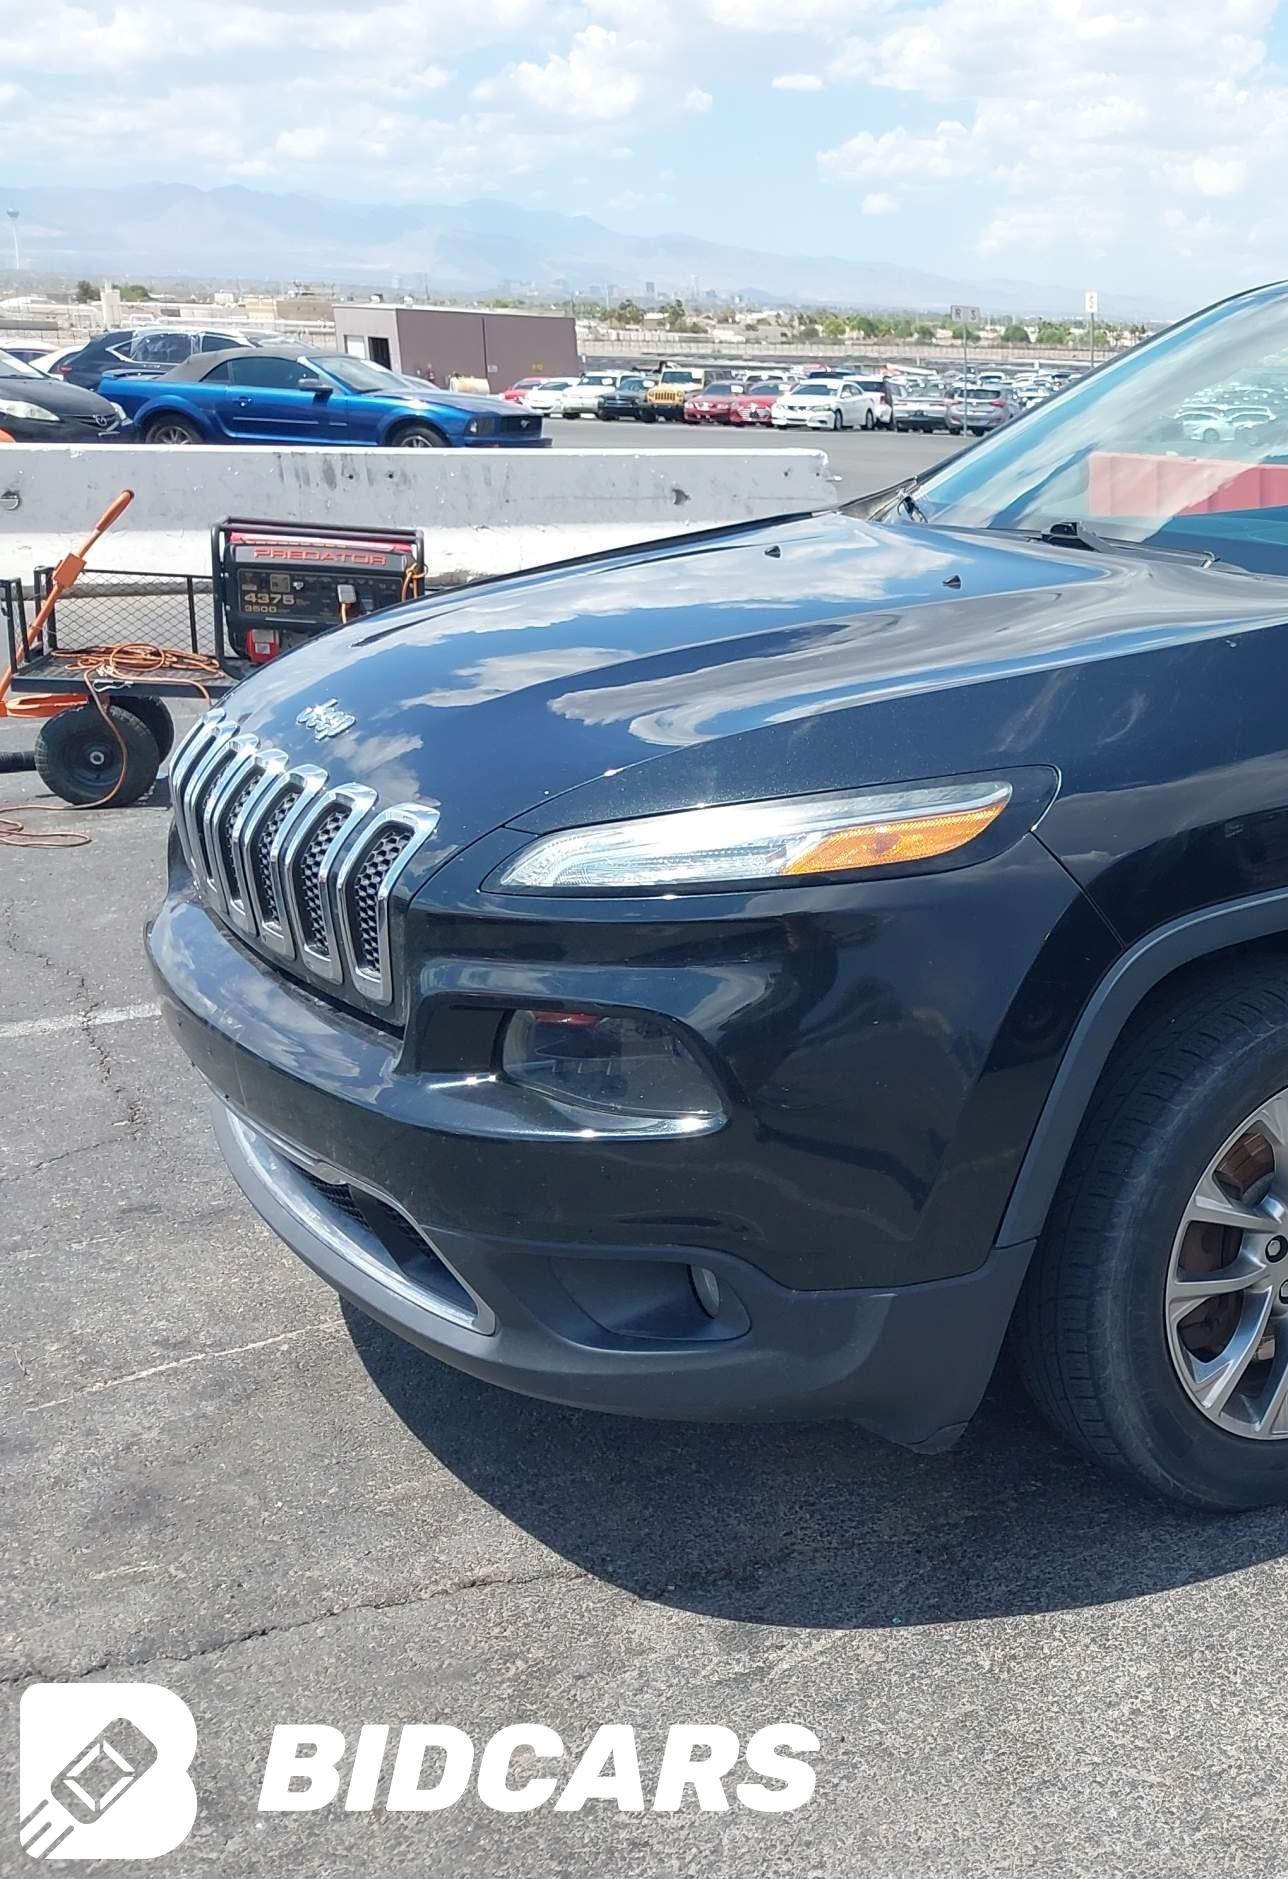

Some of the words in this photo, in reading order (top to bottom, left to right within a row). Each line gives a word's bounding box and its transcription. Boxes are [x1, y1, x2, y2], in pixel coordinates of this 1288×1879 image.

[254, 548, 386, 566] PREDATOR
[244, 592, 295, 605] 4375
[244, 604, 277, 613] 3500
